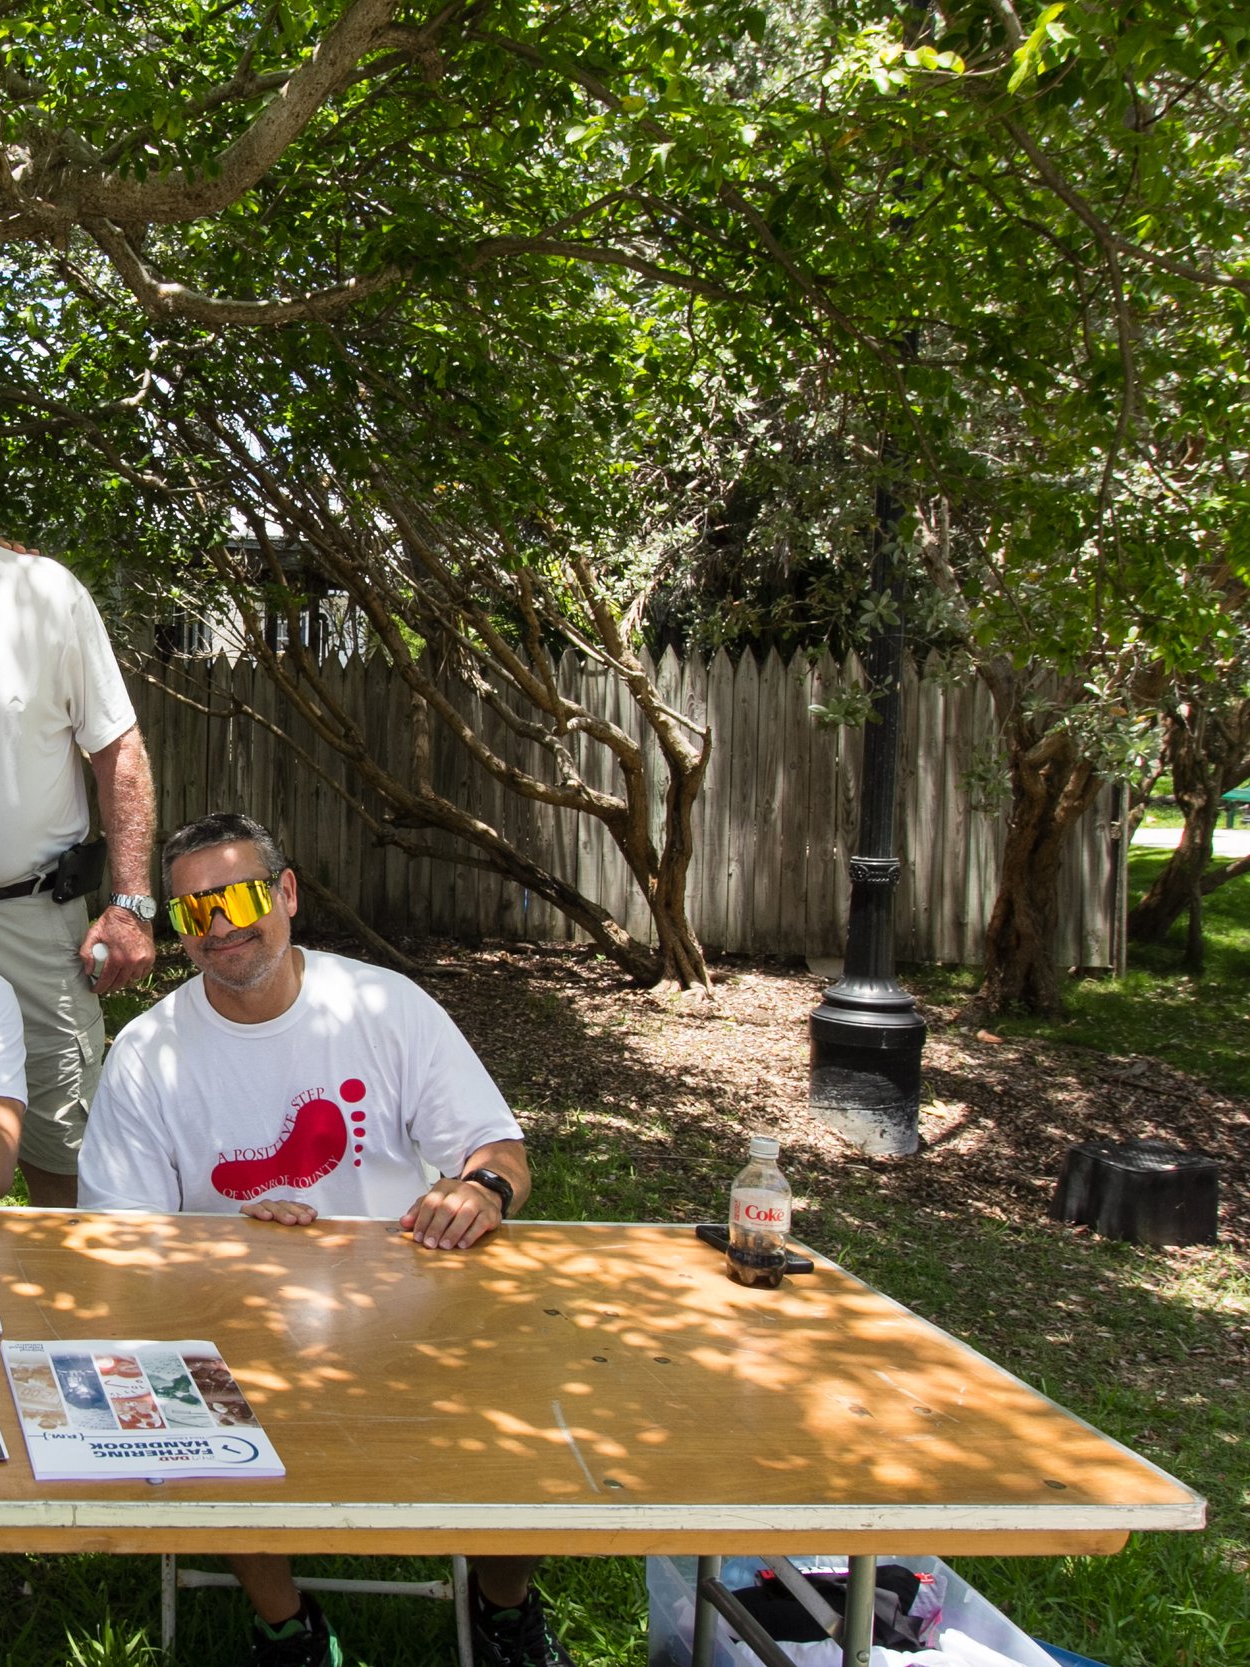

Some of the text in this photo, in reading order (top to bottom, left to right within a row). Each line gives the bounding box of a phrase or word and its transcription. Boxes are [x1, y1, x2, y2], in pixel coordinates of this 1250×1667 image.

[218, 1087, 325, 1164] A POSITIVE STEP
[222, 1155, 339, 1200] OF MONROE COUNTY
[745, 1204, 784, 1222] Coke
[89, 1440, 210, 1450] HANDBOOK
[93, 1448, 214, 1458] FATHERING
